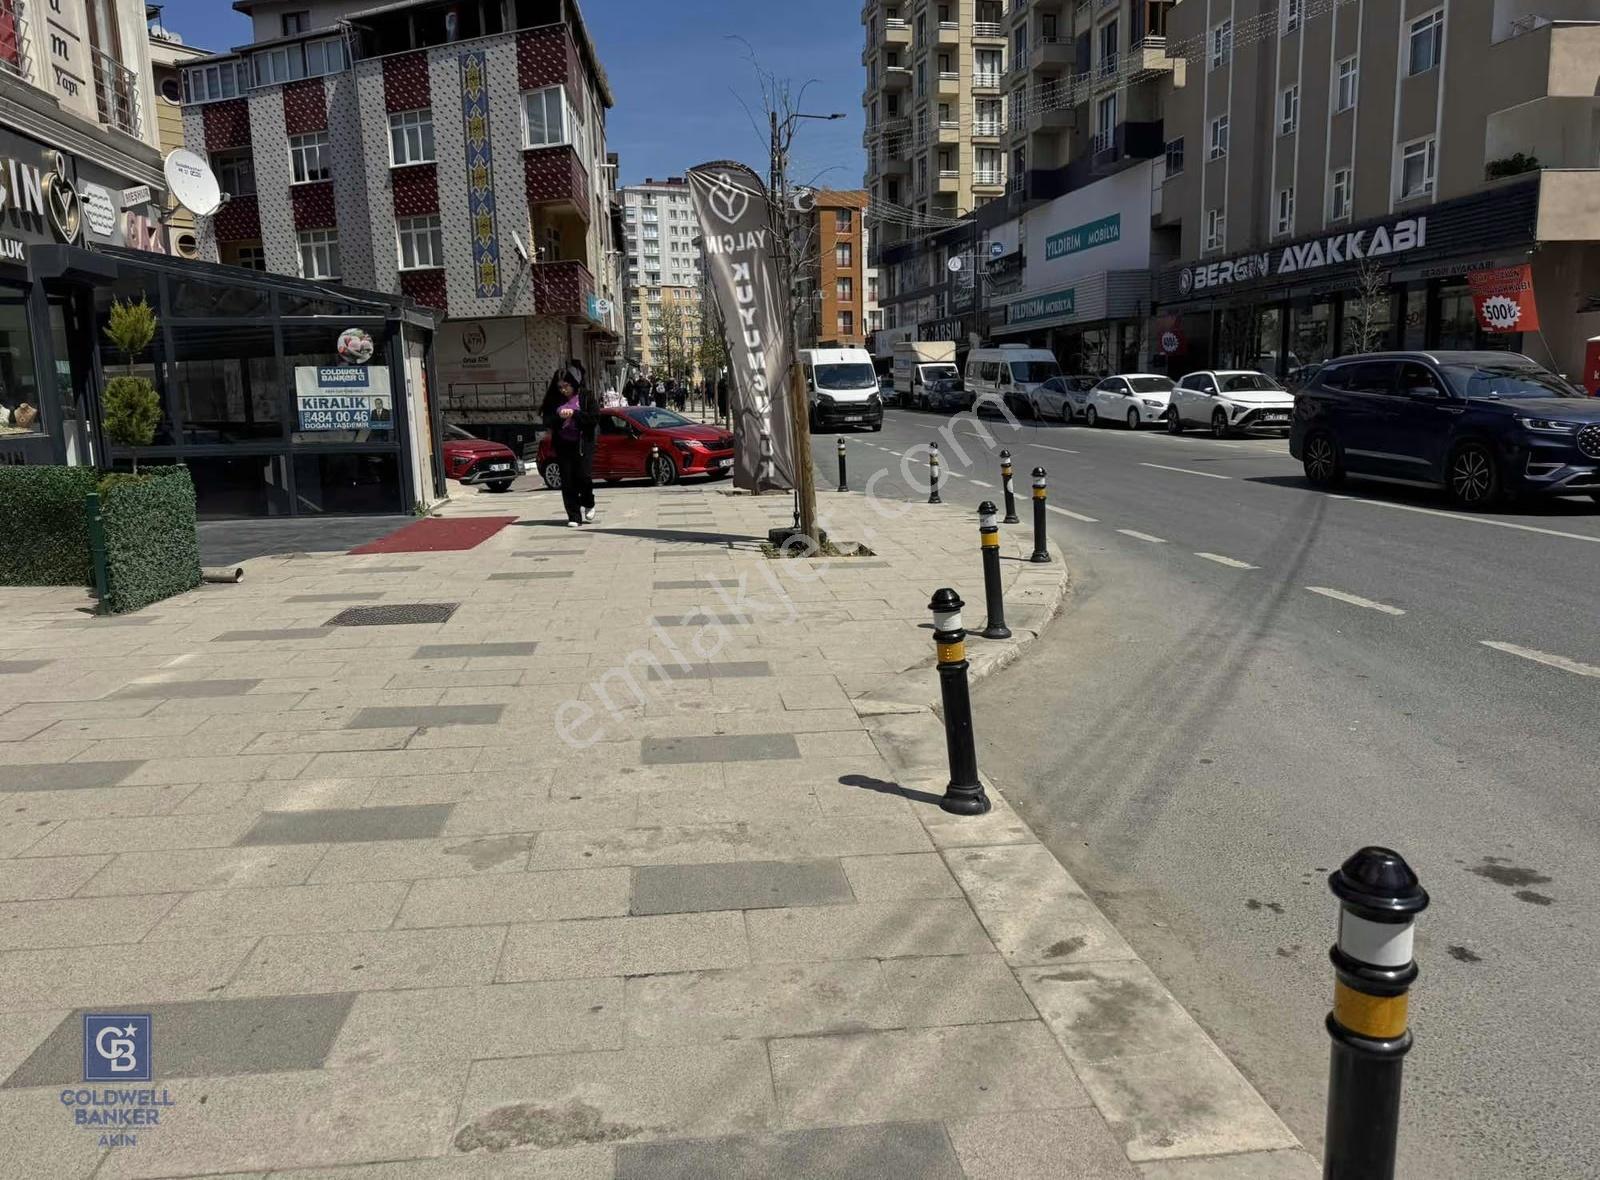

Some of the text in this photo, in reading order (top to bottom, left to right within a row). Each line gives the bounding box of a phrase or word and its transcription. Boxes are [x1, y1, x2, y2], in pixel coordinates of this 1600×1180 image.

[0, 158, 44, 215] IN
[1047, 223, 1119, 257] YILDIRIM MOBİLYA
[1277, 217, 1427, 274] AYAKKABI
[1010, 299, 1044, 320] YILDIRIM
[310, 411, 332, 423] 484
[335, 411, 350, 422] 00
[353, 410, 368, 422] 46
